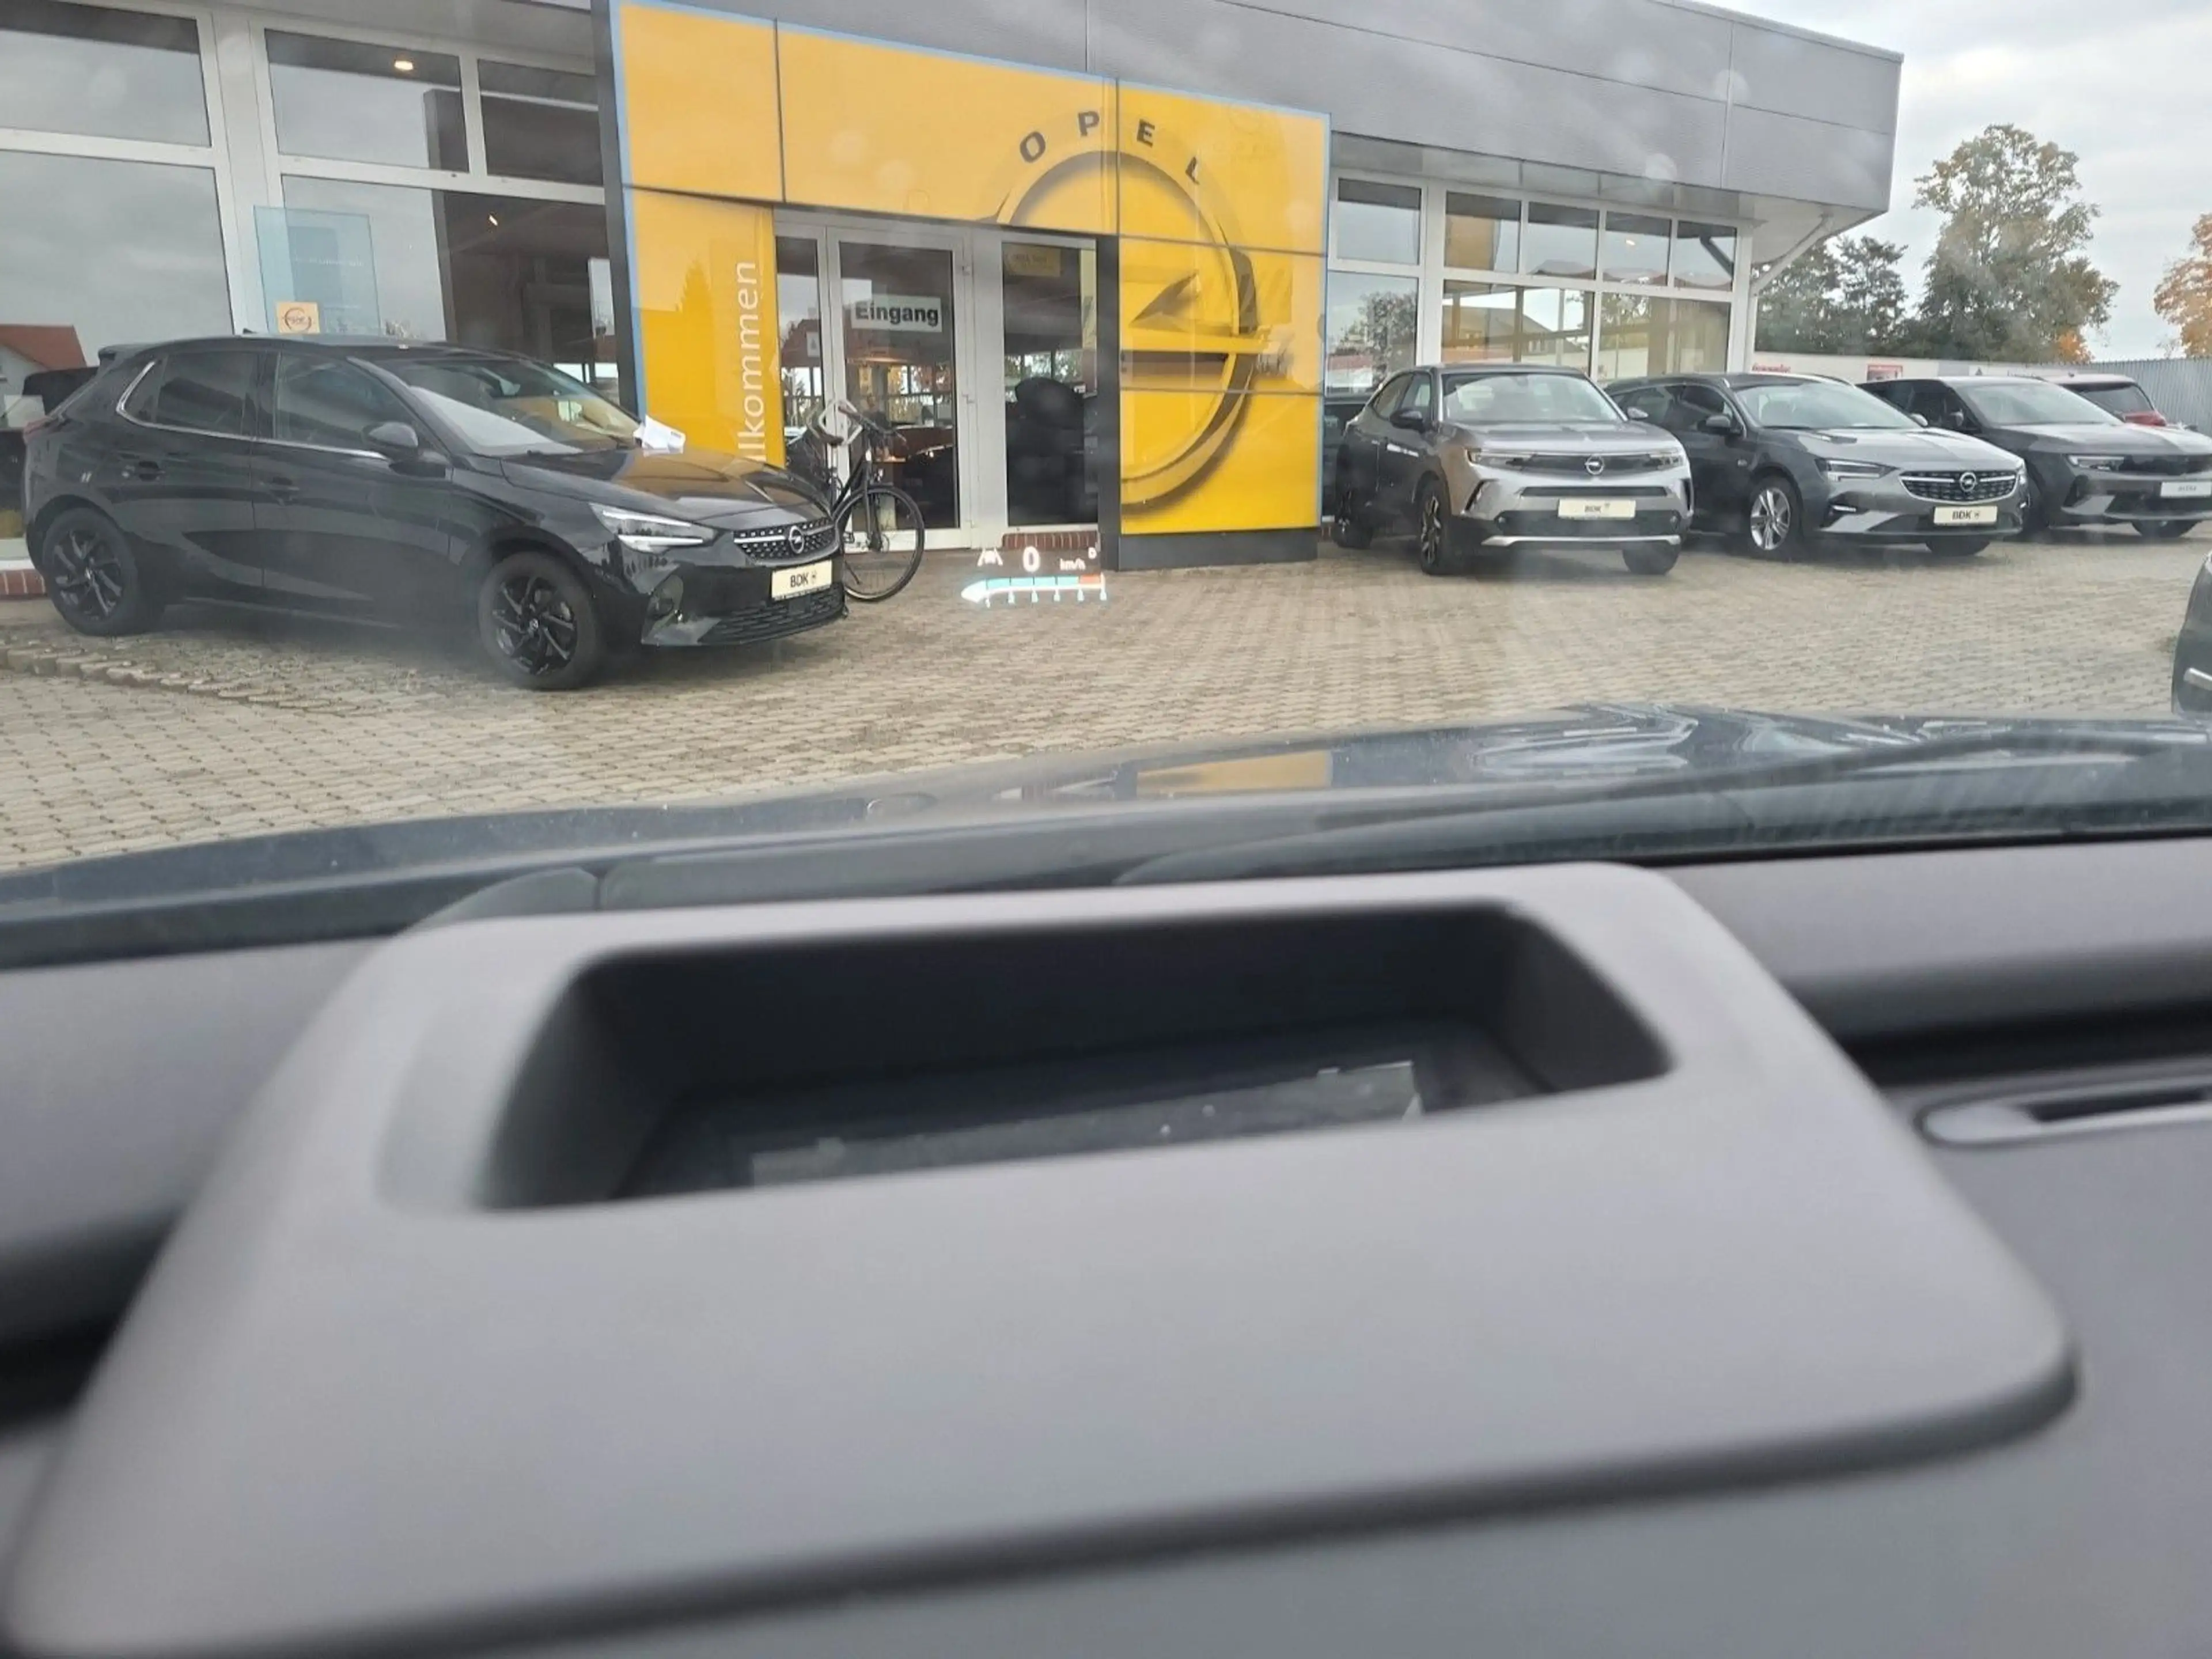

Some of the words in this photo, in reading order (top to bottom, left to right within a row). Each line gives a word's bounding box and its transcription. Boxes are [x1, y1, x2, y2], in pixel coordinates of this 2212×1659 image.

[1020, 111, 1200, 184] OPEL
[855, 300, 938, 327] Eingang
[1023, 546, 1040, 572] 0
[1060, 558, 1086, 570] km/h
[790, 573, 808, 588] BDK
